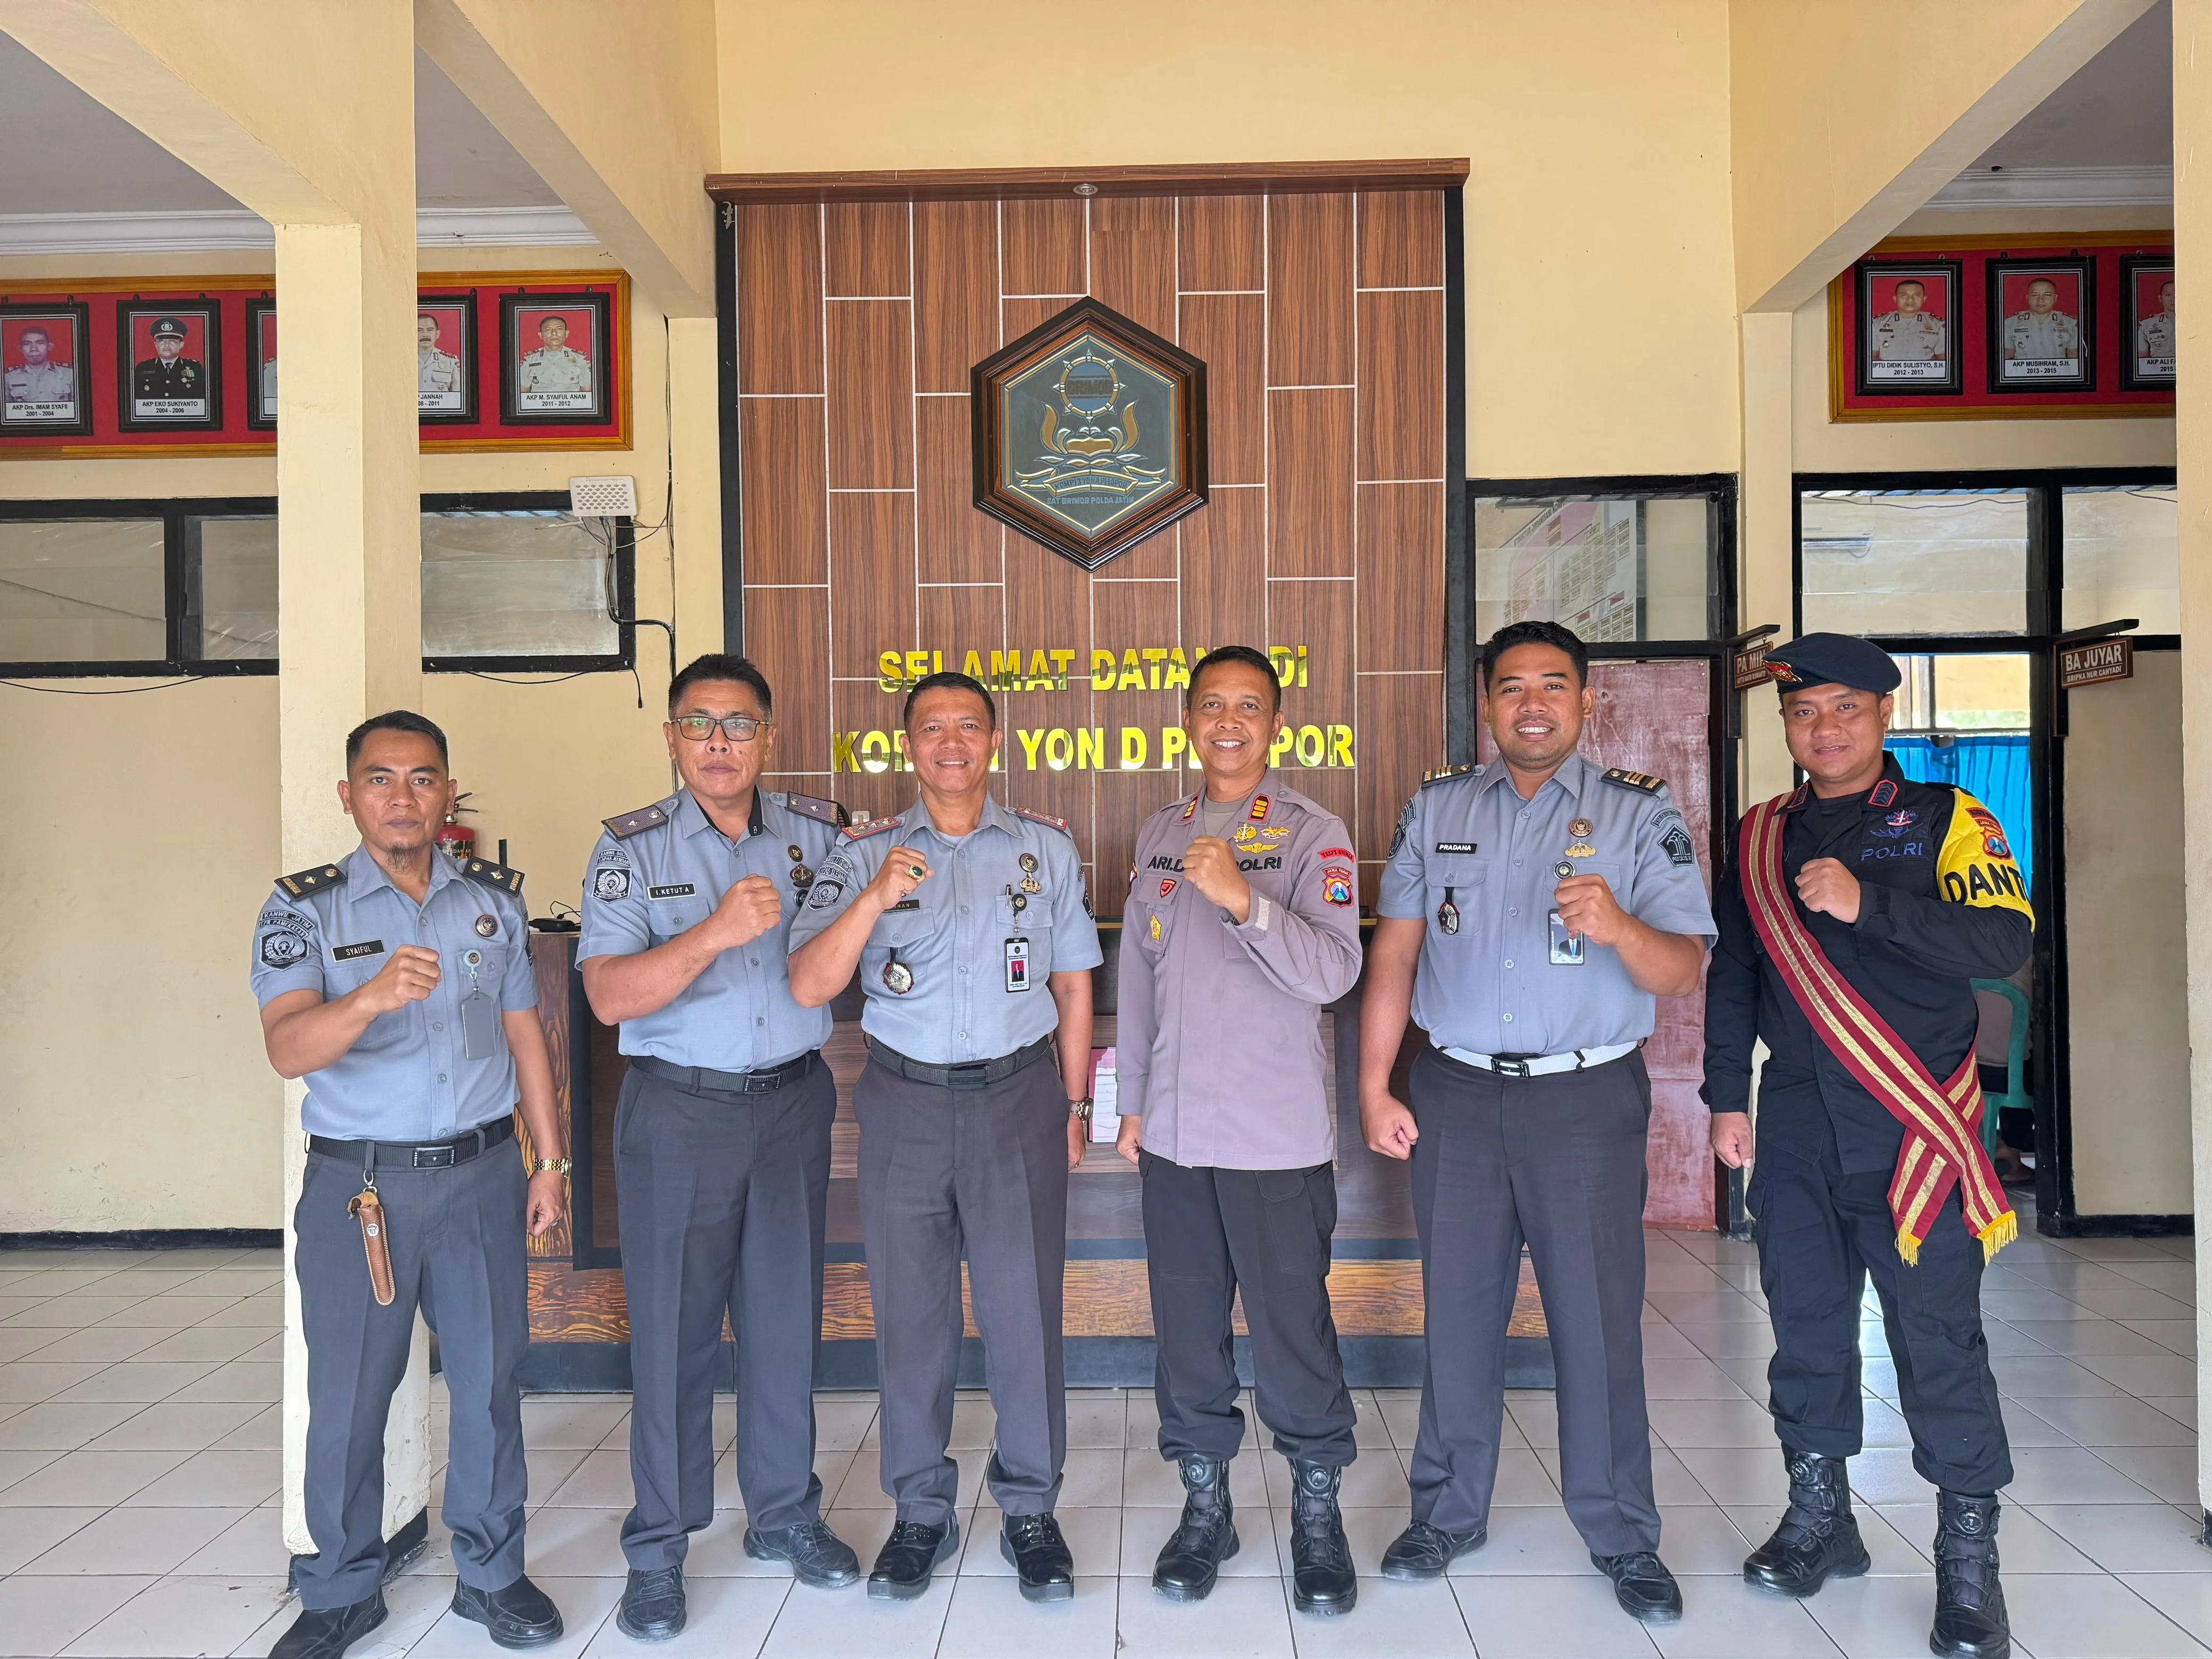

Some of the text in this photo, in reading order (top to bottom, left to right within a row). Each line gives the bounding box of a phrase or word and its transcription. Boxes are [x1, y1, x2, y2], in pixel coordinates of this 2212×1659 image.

[1054, 479, 1076, 488] KOMPI
[1101, 477, 1127, 488] PELOPOR
[1737, 656, 1748, 674] PA
[2065, 644, 2123, 672] BA JUYAR
[1091, 647, 1222, 691] DATA
[1269, 645, 1309, 689] DI
[2067, 672, 2086, 682] BRIPKA
[2087, 670, 2098, 678] NUR
[1016, 727, 1104, 771] YON
[1121, 727, 1147, 770] D
[1861, 842, 1923, 861] POLRI
[1236, 856, 1282, 872] OLRI
[656, 887, 683, 895] I.KETUT
[273, 920, 305, 939] PAMEKASAN
[291, 915, 312, 929] JATIM
[346, 945, 372, 956] SYAIFUL
